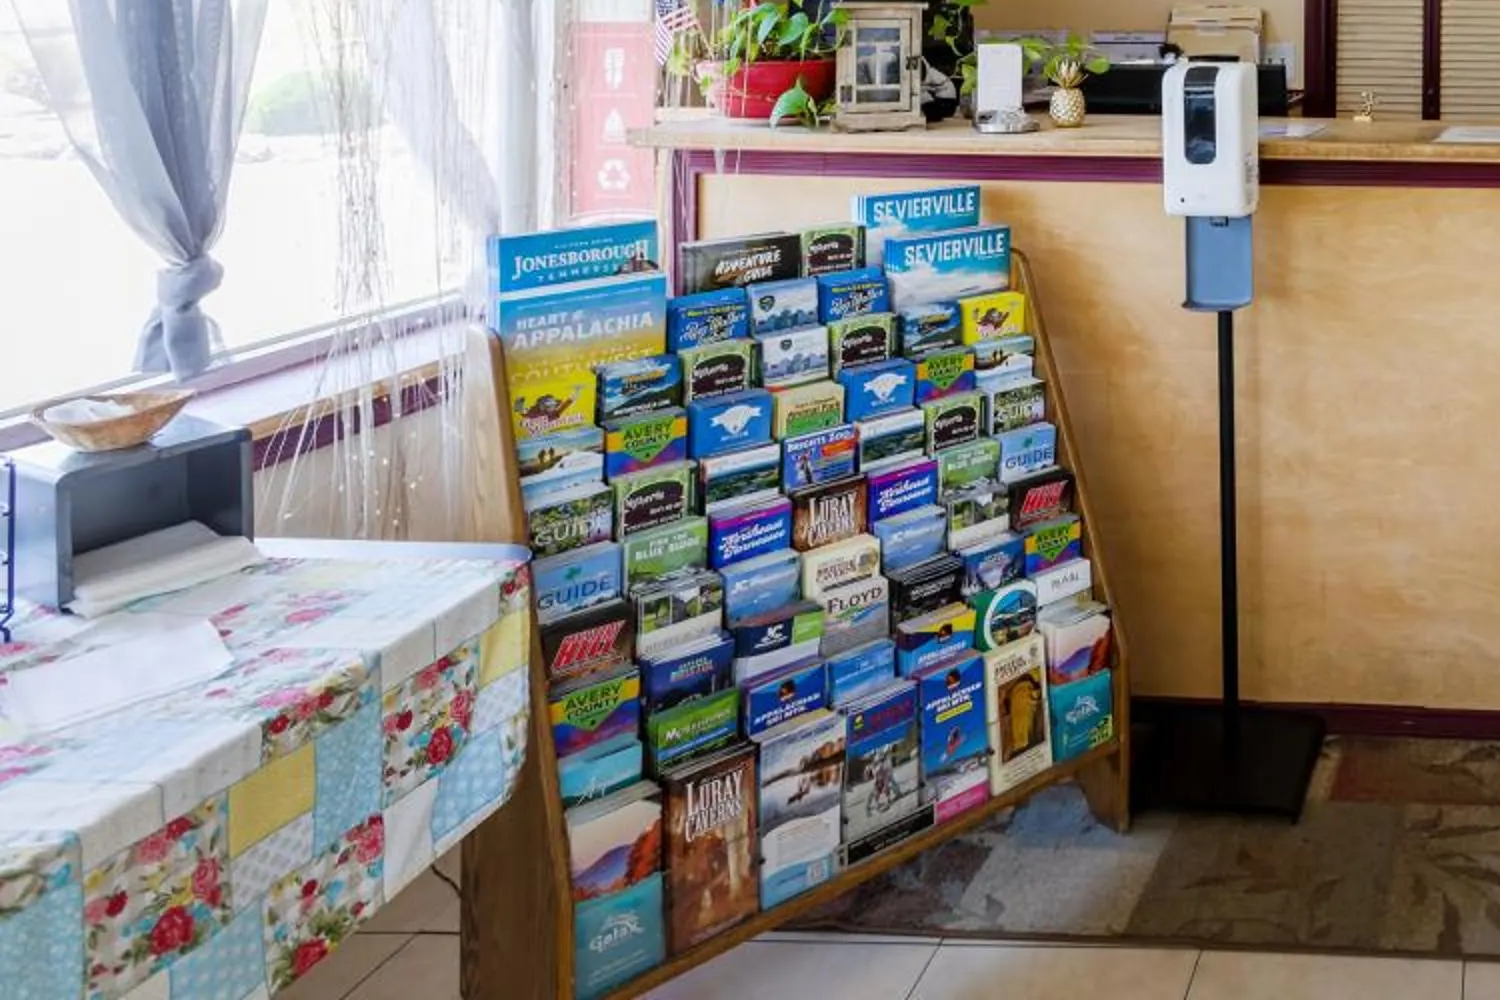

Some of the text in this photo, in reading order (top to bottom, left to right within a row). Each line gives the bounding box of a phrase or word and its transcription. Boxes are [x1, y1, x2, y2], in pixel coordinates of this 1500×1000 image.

[873, 192, 975, 222] SEVIERVILLE
[512, 239, 650, 280] JONESBOROUGH
[715, 249, 782, 276] ADVENTURE
[904, 233, 1005, 266] SEVIERVILLE
[512, 311, 655, 349] APPALACHIA
[517, 311, 569, 331] HEART
[623, 418, 671, 439] AVERY
[1005, 448, 1053, 470] GUIDE
[809, 491, 858, 524] LURAY
[538, 578, 612, 610] GUIDE
[827, 586, 882, 613] FLOYD
[566, 683, 624, 708] AVERY
[568, 696, 620, 719] COUNTY
[686, 769, 744, 818] LURAY
[685, 799, 743, 843] CAVERNS
